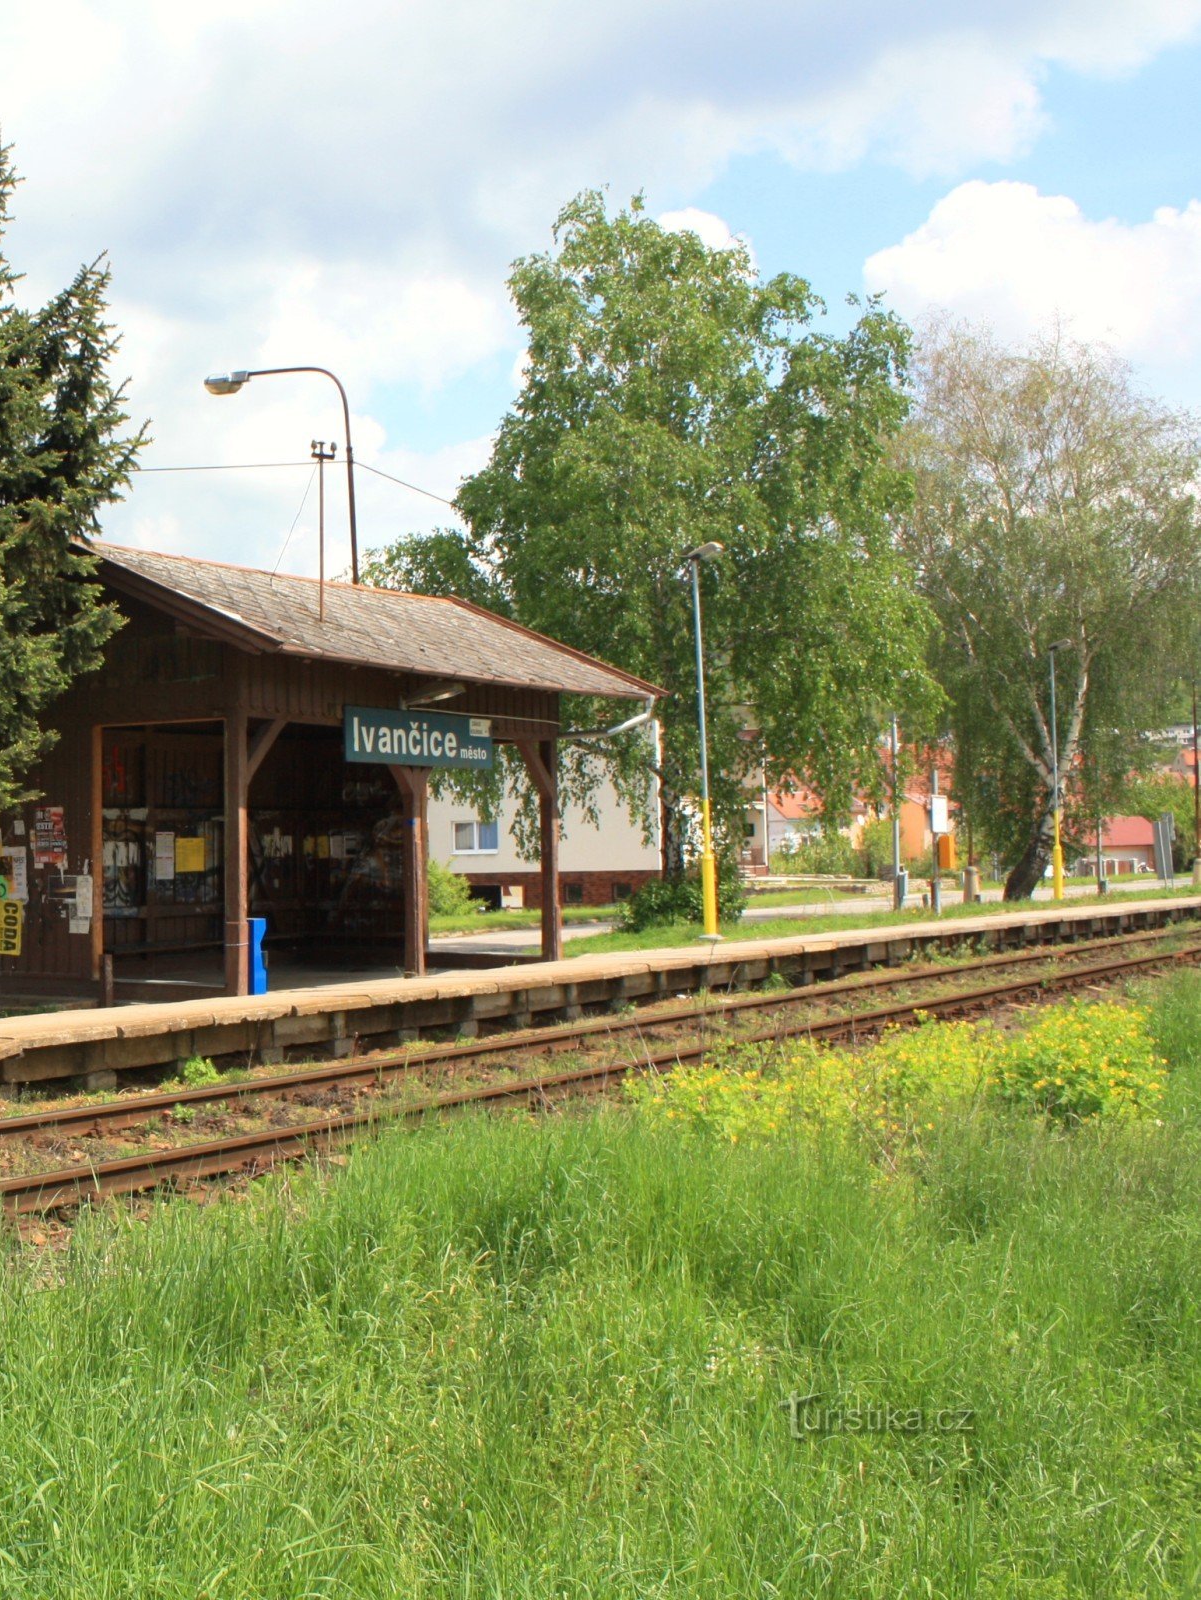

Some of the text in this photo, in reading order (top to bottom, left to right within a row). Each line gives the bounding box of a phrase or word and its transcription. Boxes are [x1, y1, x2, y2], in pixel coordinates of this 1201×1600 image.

[353, 716, 487, 761] Ivančice město
[3, 902, 19, 951] CODA
